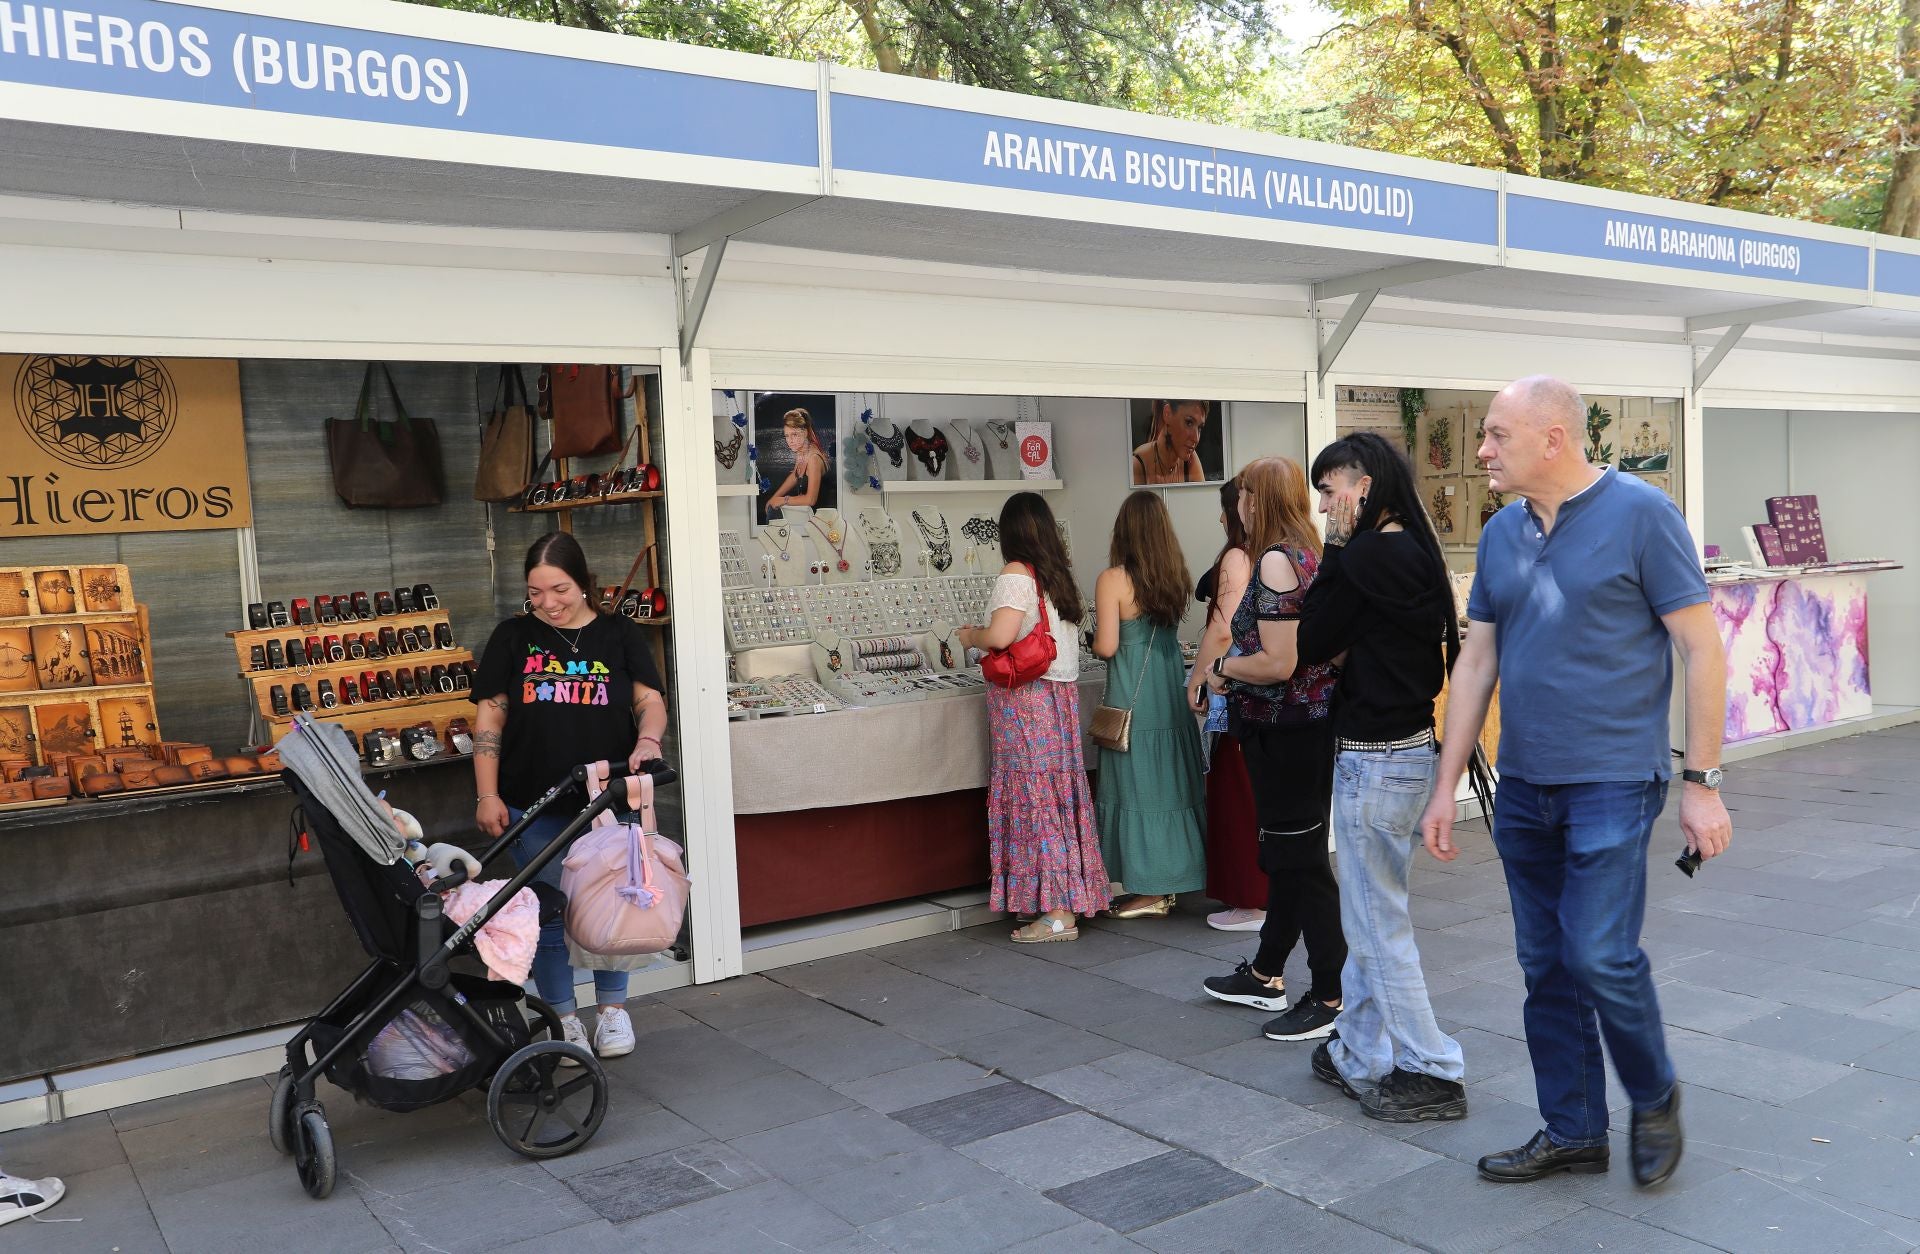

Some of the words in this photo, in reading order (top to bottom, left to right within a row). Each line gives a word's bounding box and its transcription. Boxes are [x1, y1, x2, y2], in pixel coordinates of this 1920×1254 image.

[0, 1, 212, 77] HIEROS
[233, 33, 469, 117] (BURGOS)
[983, 130, 1117, 182] ARANTXA
[1125, 150, 1257, 200] BISUTERIA
[1264, 169, 1414, 226] (VALLADOLID)
[1604, 220, 1657, 252] AMAYA
[1660, 228, 1736, 262] BARAHONA
[1739, 239, 1801, 275] (BURGOS)
